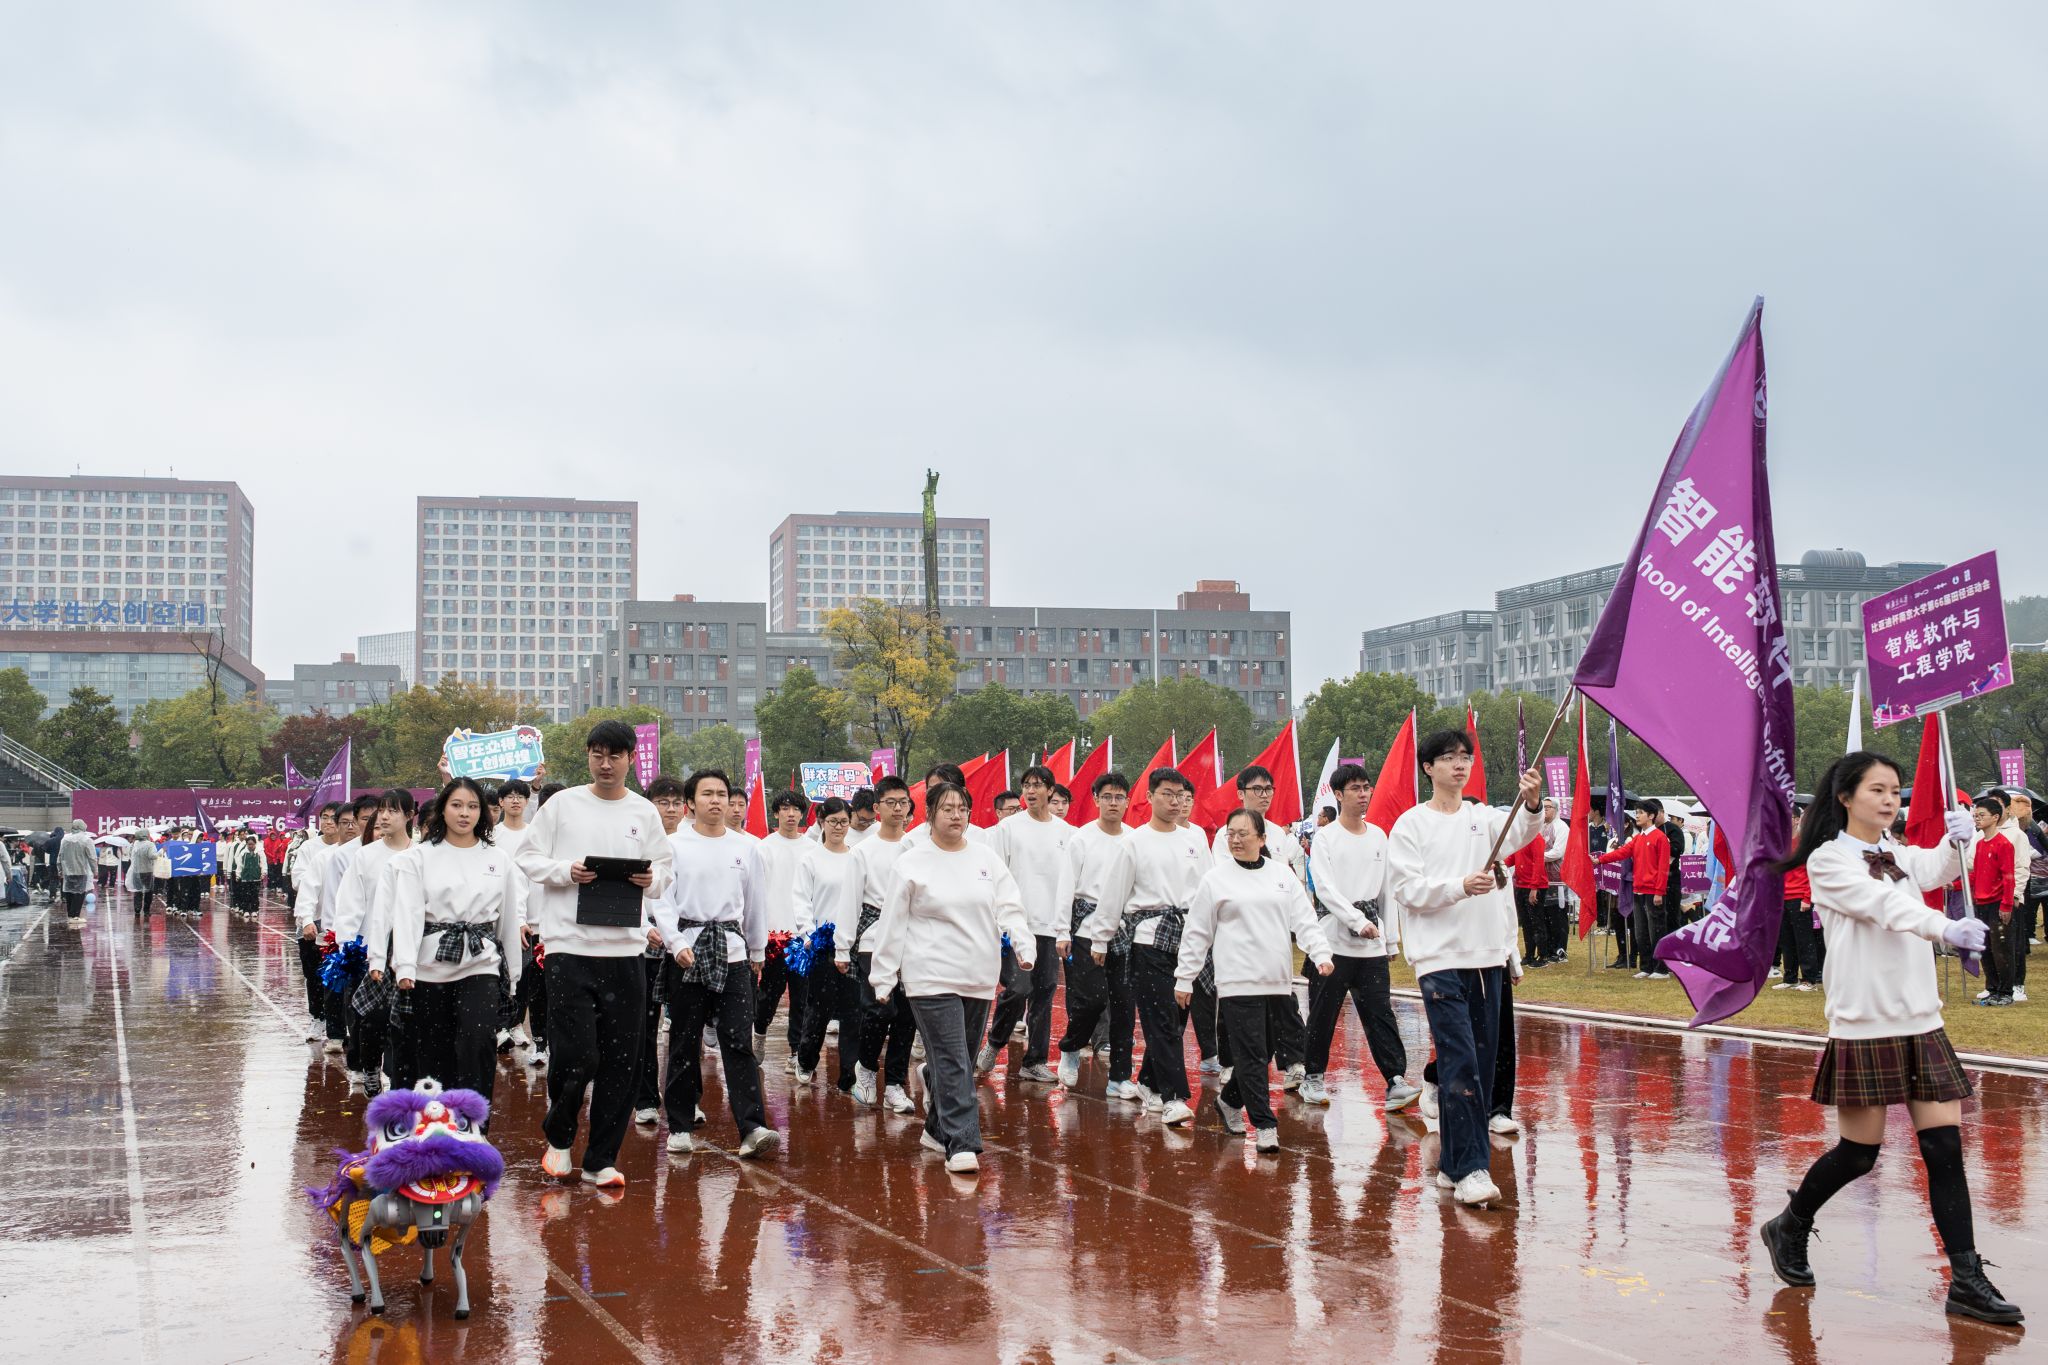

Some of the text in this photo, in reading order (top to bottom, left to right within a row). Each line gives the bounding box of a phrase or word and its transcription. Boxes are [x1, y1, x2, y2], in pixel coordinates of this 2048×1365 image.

[1, 599, 206, 625] 大学生众创空间
[1884, 607, 1981, 659] 智能软件与
[1637, 553, 1688, 603] hool
[1681, 599, 1710, 623] of
[1763, 721, 1796, 808] Softwa
[1897, 639, 1976, 684] 工程学院
